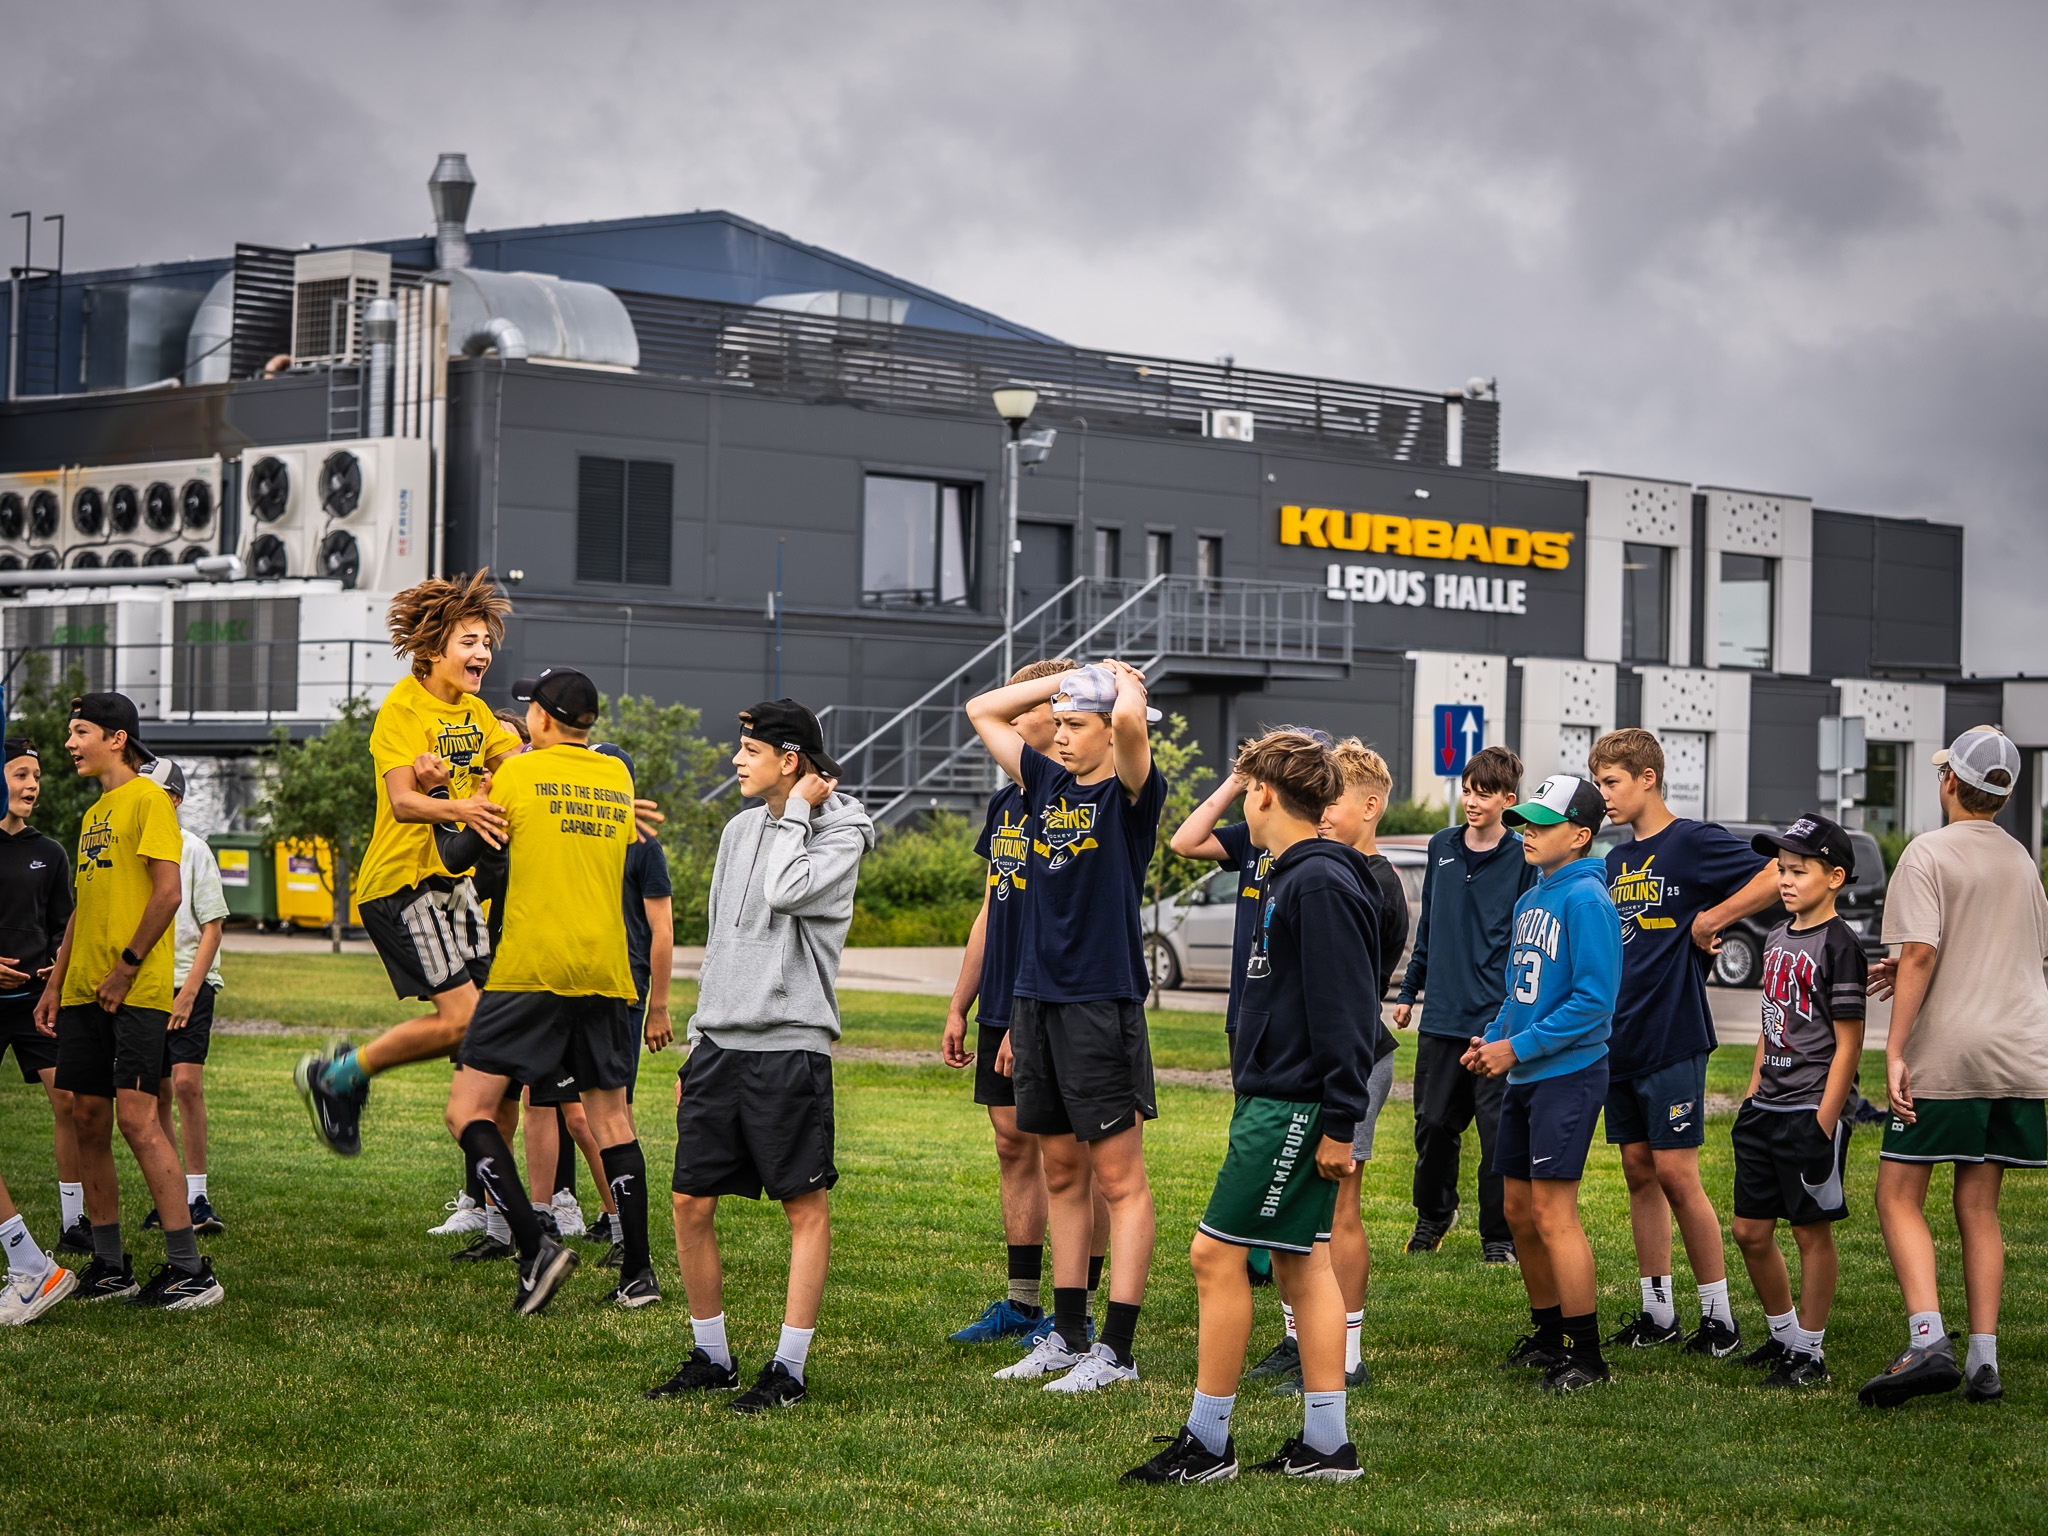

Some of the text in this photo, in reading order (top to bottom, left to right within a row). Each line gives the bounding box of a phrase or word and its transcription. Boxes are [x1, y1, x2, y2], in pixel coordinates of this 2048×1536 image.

[1280, 506, 1574, 569] KURBADS
[1327, 564, 1527, 615] LEDUS HALLE
[535, 783, 558, 796] THIS
[561, 784, 571, 796] IS
[574, 785, 590, 799] THE
[550, 801, 627, 824] OF WHAT WE ARE
[561, 819, 603, 838] CAPABLE
[993, 838, 1026, 861] VITOLINS
[1667, 886, 1680, 897] 25
[1771, 1055, 1792, 1067] CLUB
[1260, 1112, 1309, 1218] BHK MĀRUPE
